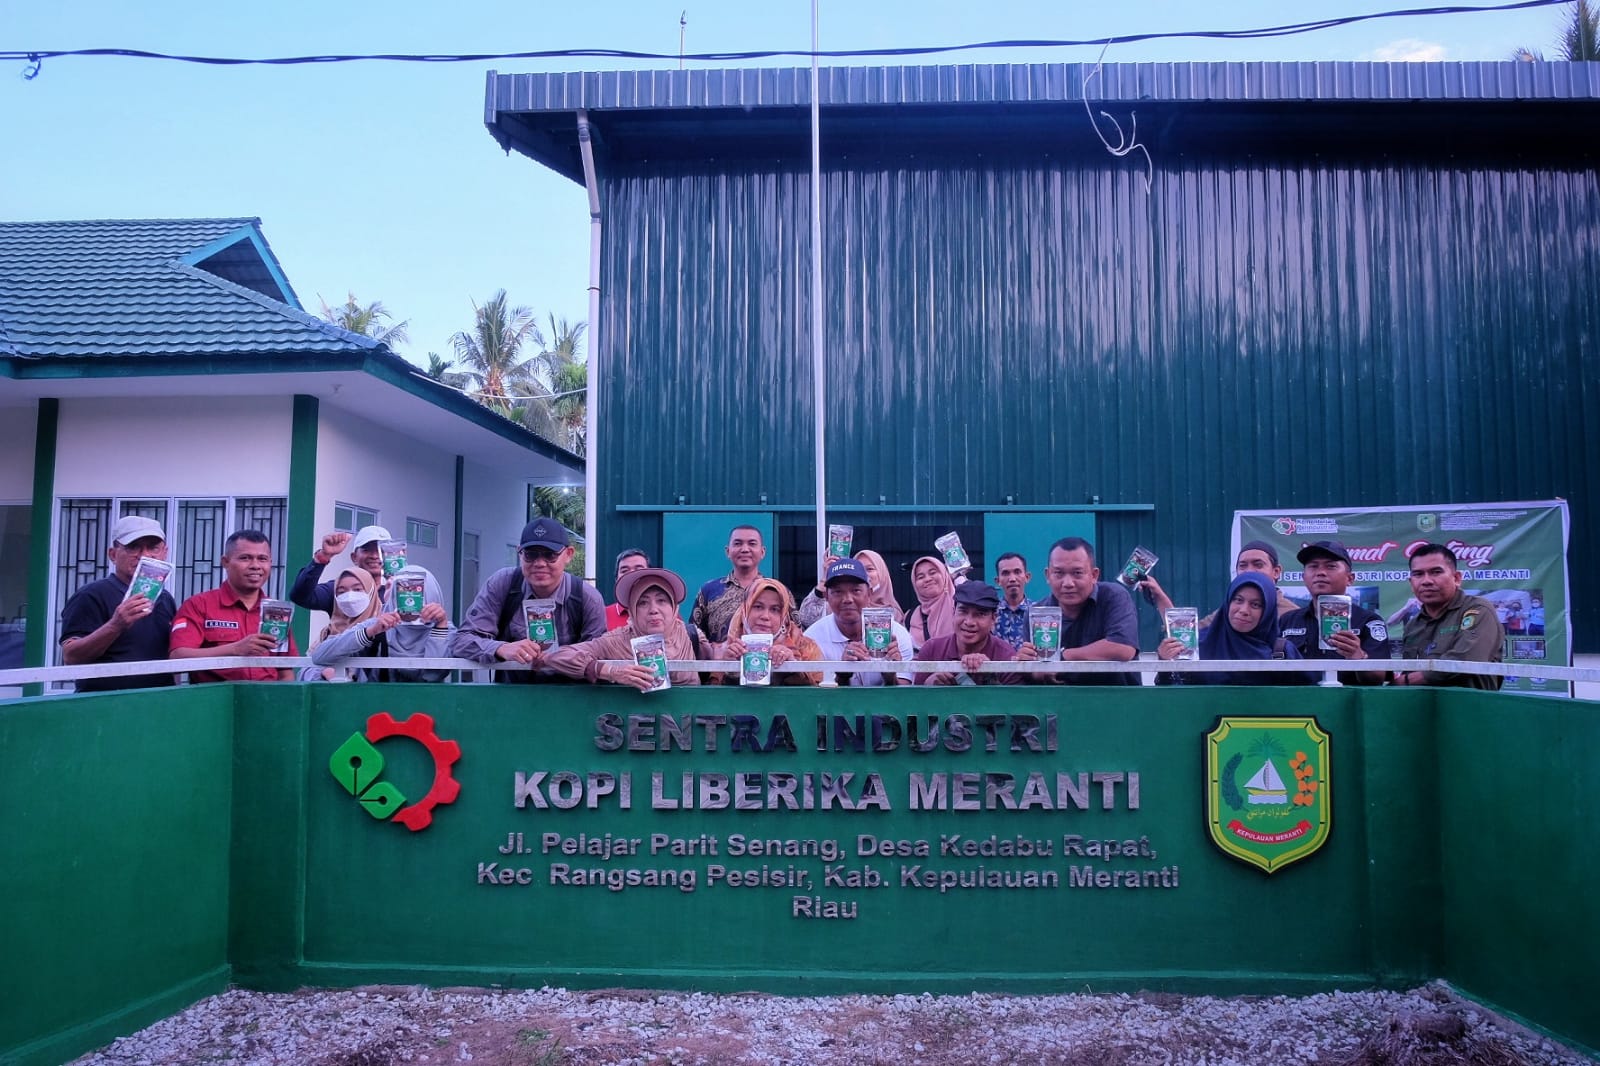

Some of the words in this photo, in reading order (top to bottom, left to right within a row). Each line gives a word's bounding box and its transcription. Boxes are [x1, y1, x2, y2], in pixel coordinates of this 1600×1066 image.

[832, 563, 855, 573] FRANCE
[1385, 571, 1409, 581] KOP
[1475, 569, 1530, 580] MERANTI
[594, 713, 798, 752] SENTRA
[816, 713, 1059, 752] INDUSTRI
[514, 771, 632, 810] KOPI
[651, 771, 892, 811] LIBERIKA
[909, 771, 1140, 811] MERANTI
[499, 832, 532, 855] Jl.
[542, 832, 641, 860] Pelajar
[650, 833, 718, 856] Parit
[727, 833, 846, 862] Senang,
[857, 834, 930, 857] Desa
[940, 834, 1053, 857] Kedabu
[1063, 834, 1157, 862] Rapat,
[1237, 828, 1274, 842] KEPULAUAN
[1275, 828, 1303, 841] MERANTI
[477, 862, 533, 885] Kec
[550, 862, 698, 892] Rangsang
[707, 864, 814, 891] Pesisir,
[824, 865, 889, 888] Kab.
[901, 865, 1059, 892] Kepulauan
[1069, 865, 1180, 888] Meranti
[793, 896, 858, 919] Riau
